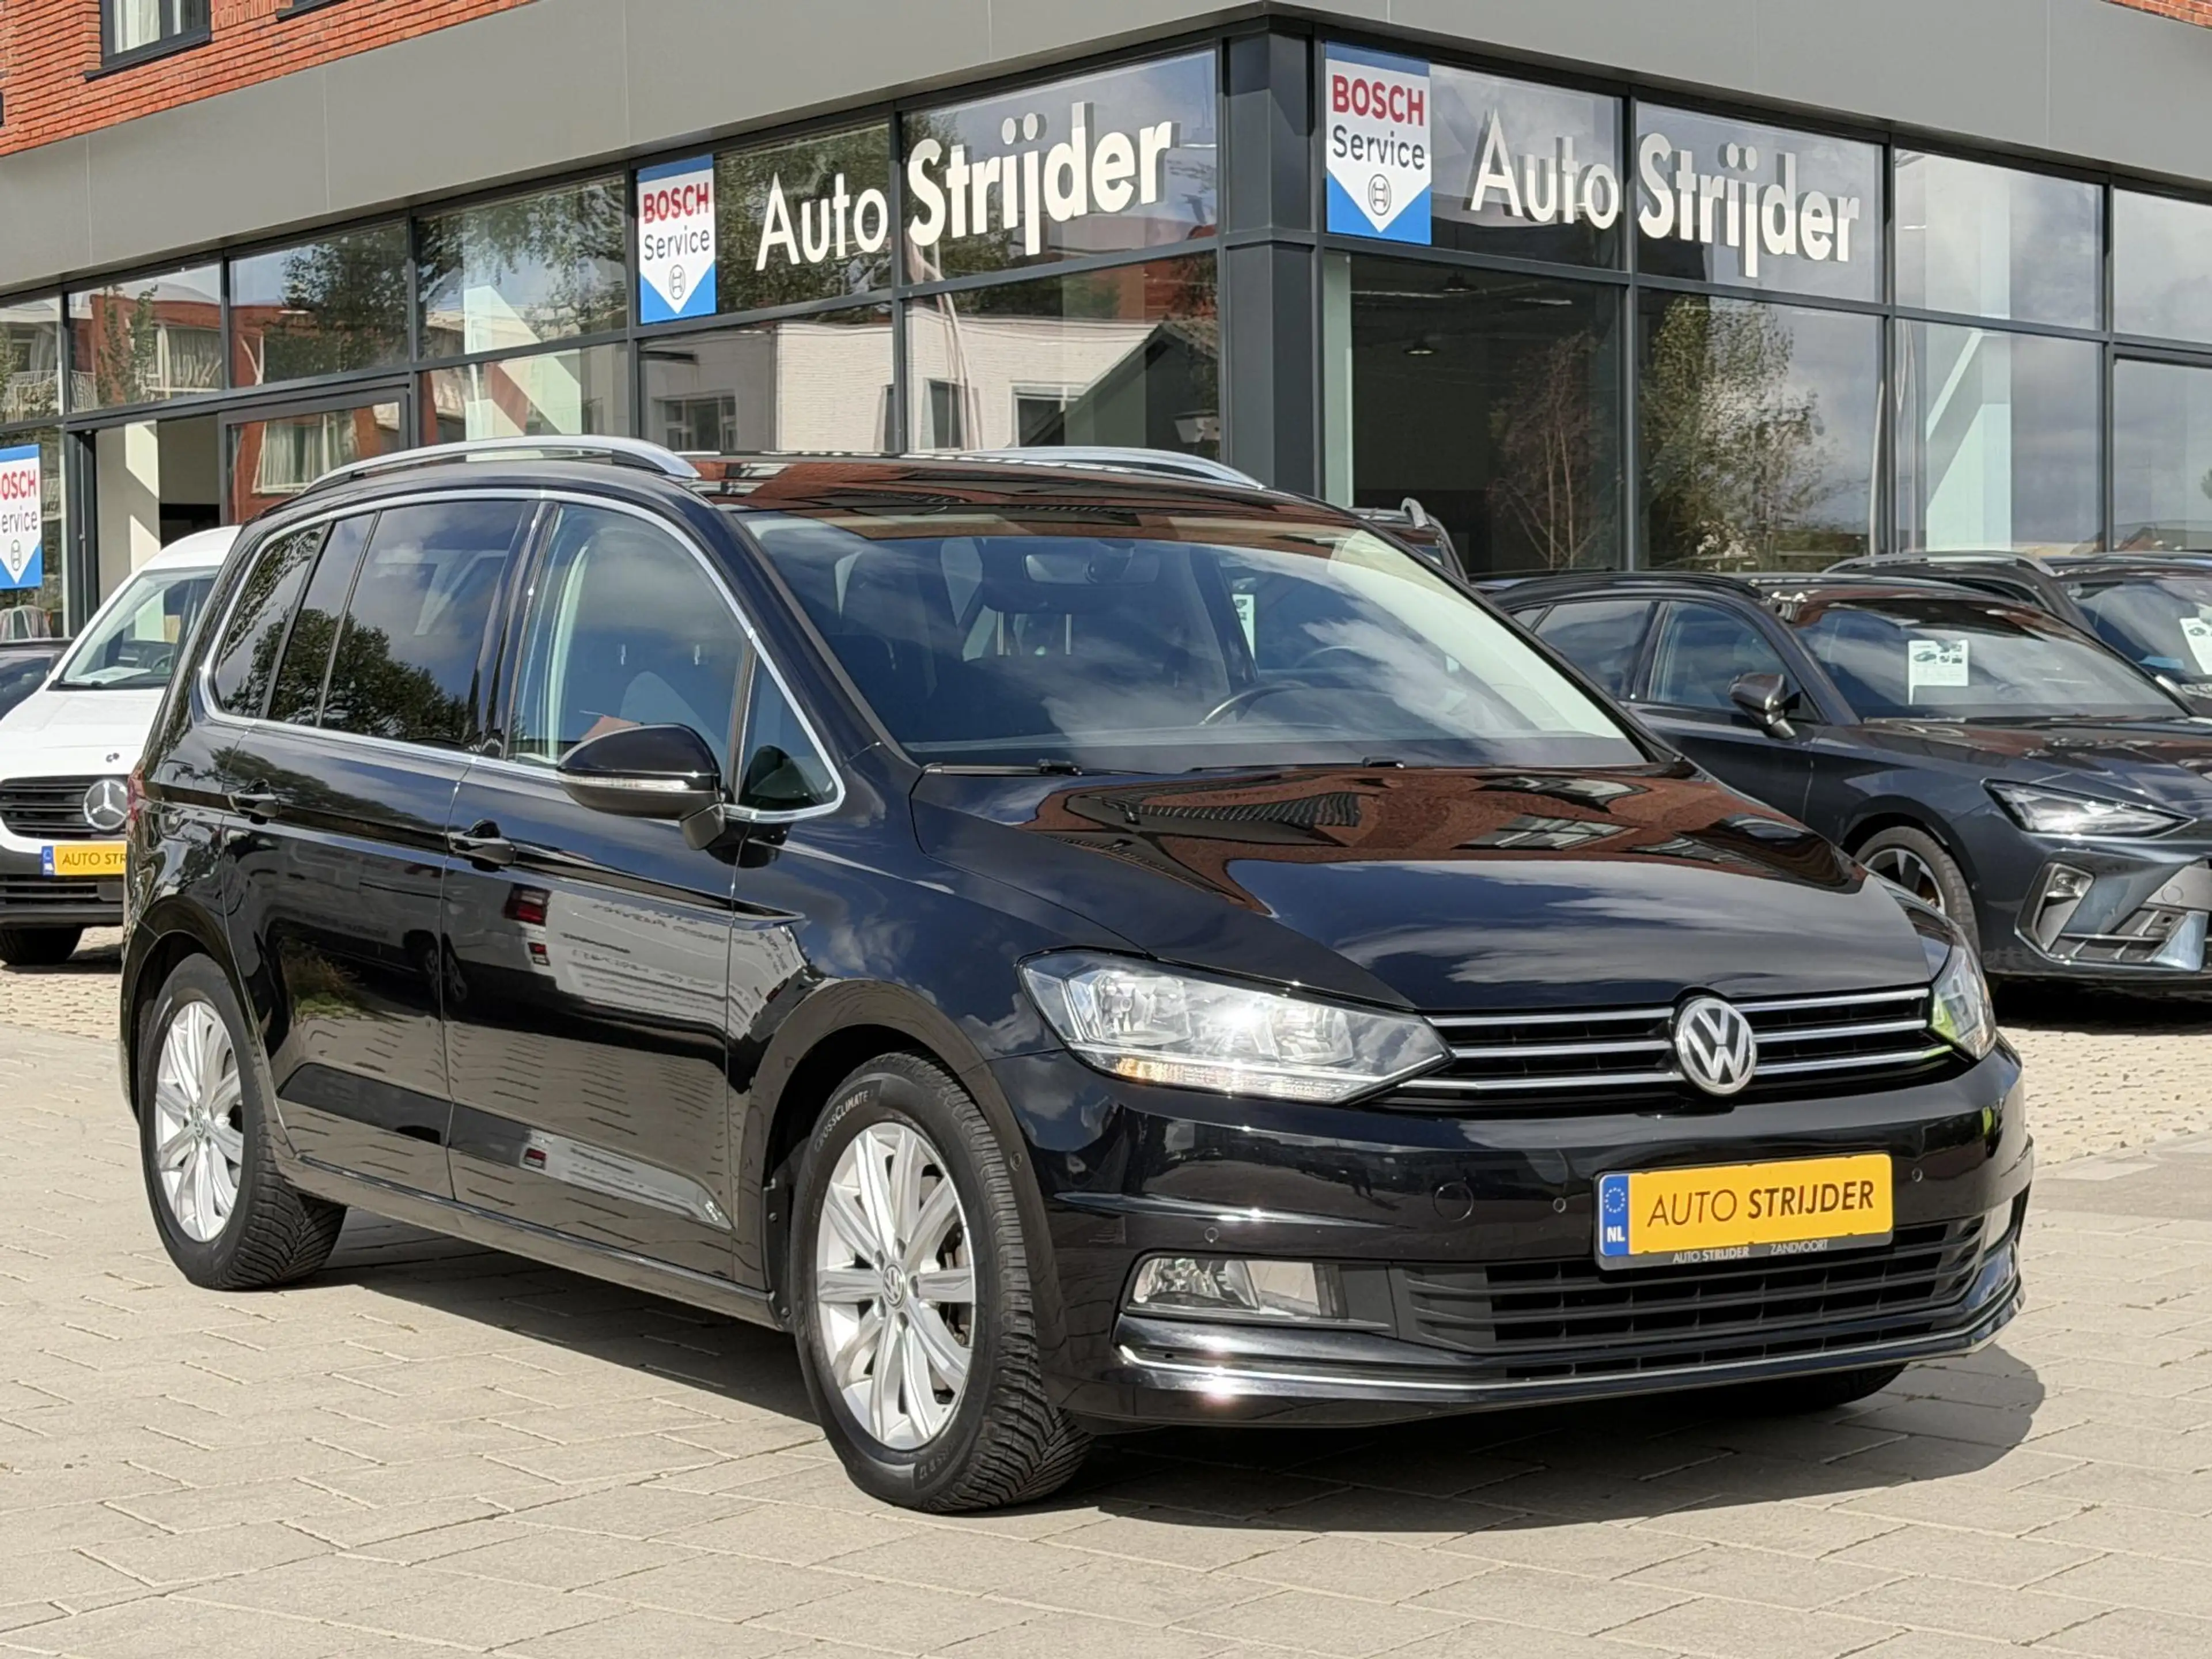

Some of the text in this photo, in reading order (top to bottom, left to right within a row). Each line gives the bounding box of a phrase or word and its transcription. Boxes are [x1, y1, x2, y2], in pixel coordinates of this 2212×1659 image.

[1332, 74, 1424, 126] BOSCH
[1332, 124, 1425, 171] Service
[643, 181, 709, 224] BOSCH
[755, 101, 1172, 271] Auto Strijder
[1470, 108, 1859, 278] Auto Strijder
[643, 225, 710, 261] Service
[1, 470, 36, 500] OSCH
[1, 505, 37, 533] ervice
[62, 853, 127, 866] AUTO STR
[1676, 998, 1756, 1094] VW
[1647, 1180, 1874, 1228] AUTO STRIJDER
[1607, 1226, 1625, 1243] NL
[1673, 1239, 1828, 1264] AUTO STRIJDER ZANDVOORT
